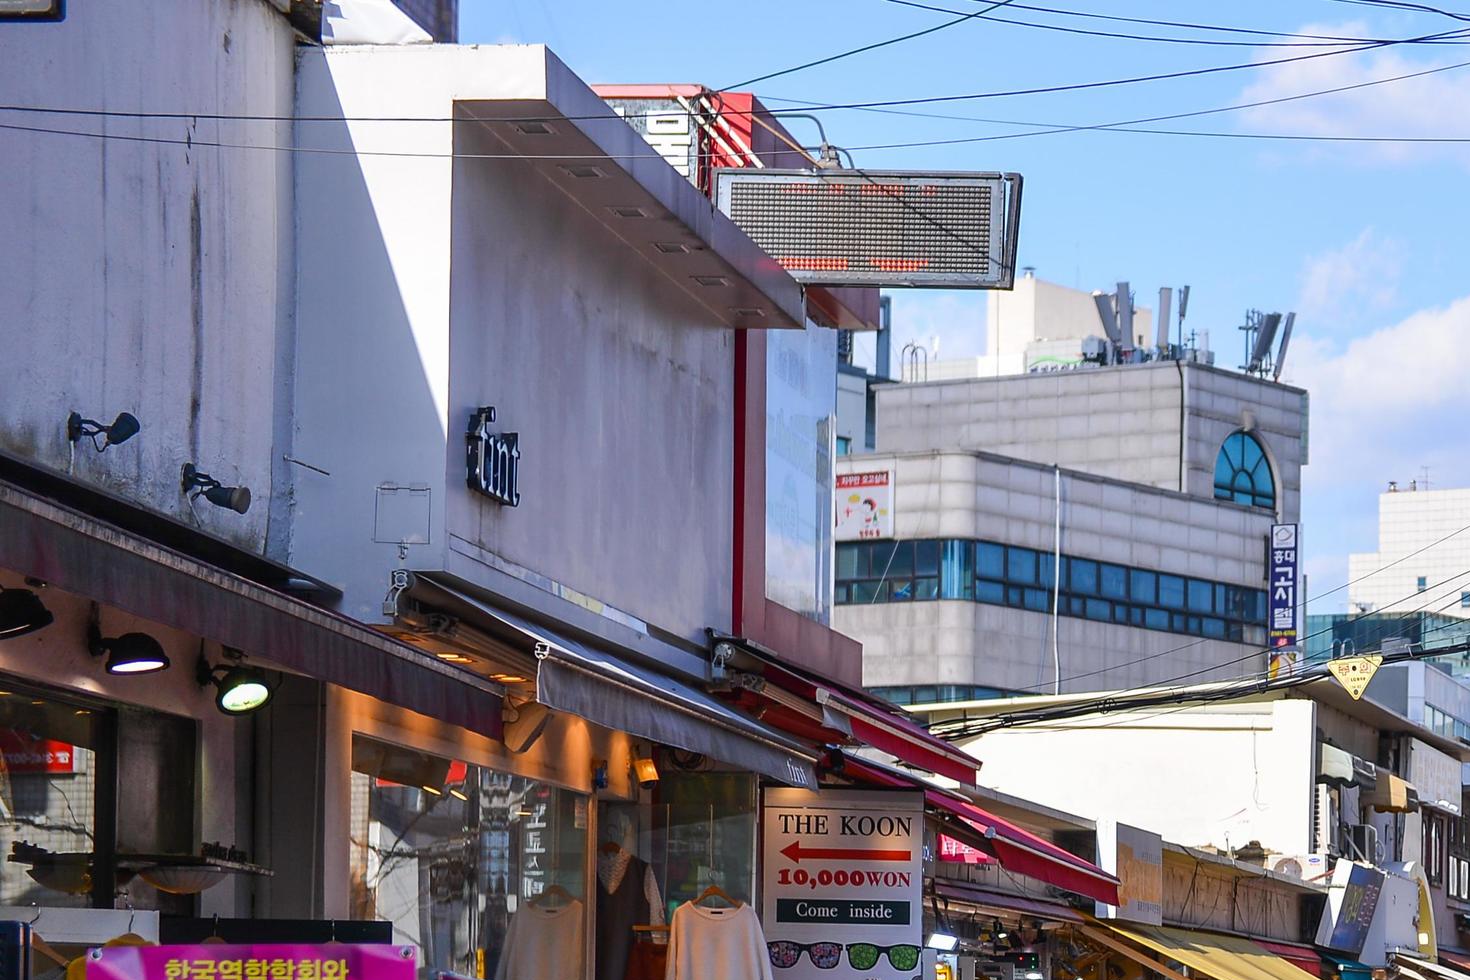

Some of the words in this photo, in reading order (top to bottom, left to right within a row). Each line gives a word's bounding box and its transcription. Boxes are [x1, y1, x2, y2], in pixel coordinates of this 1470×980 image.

[1274, 551, 1295, 563] 홍대
[1274, 567, 1293, 629] 고시텔
[779, 814, 828, 835] THE
[840, 816, 912, 837] KOON
[796, 902, 838, 918] Come
[849, 904, 893, 919] inside
